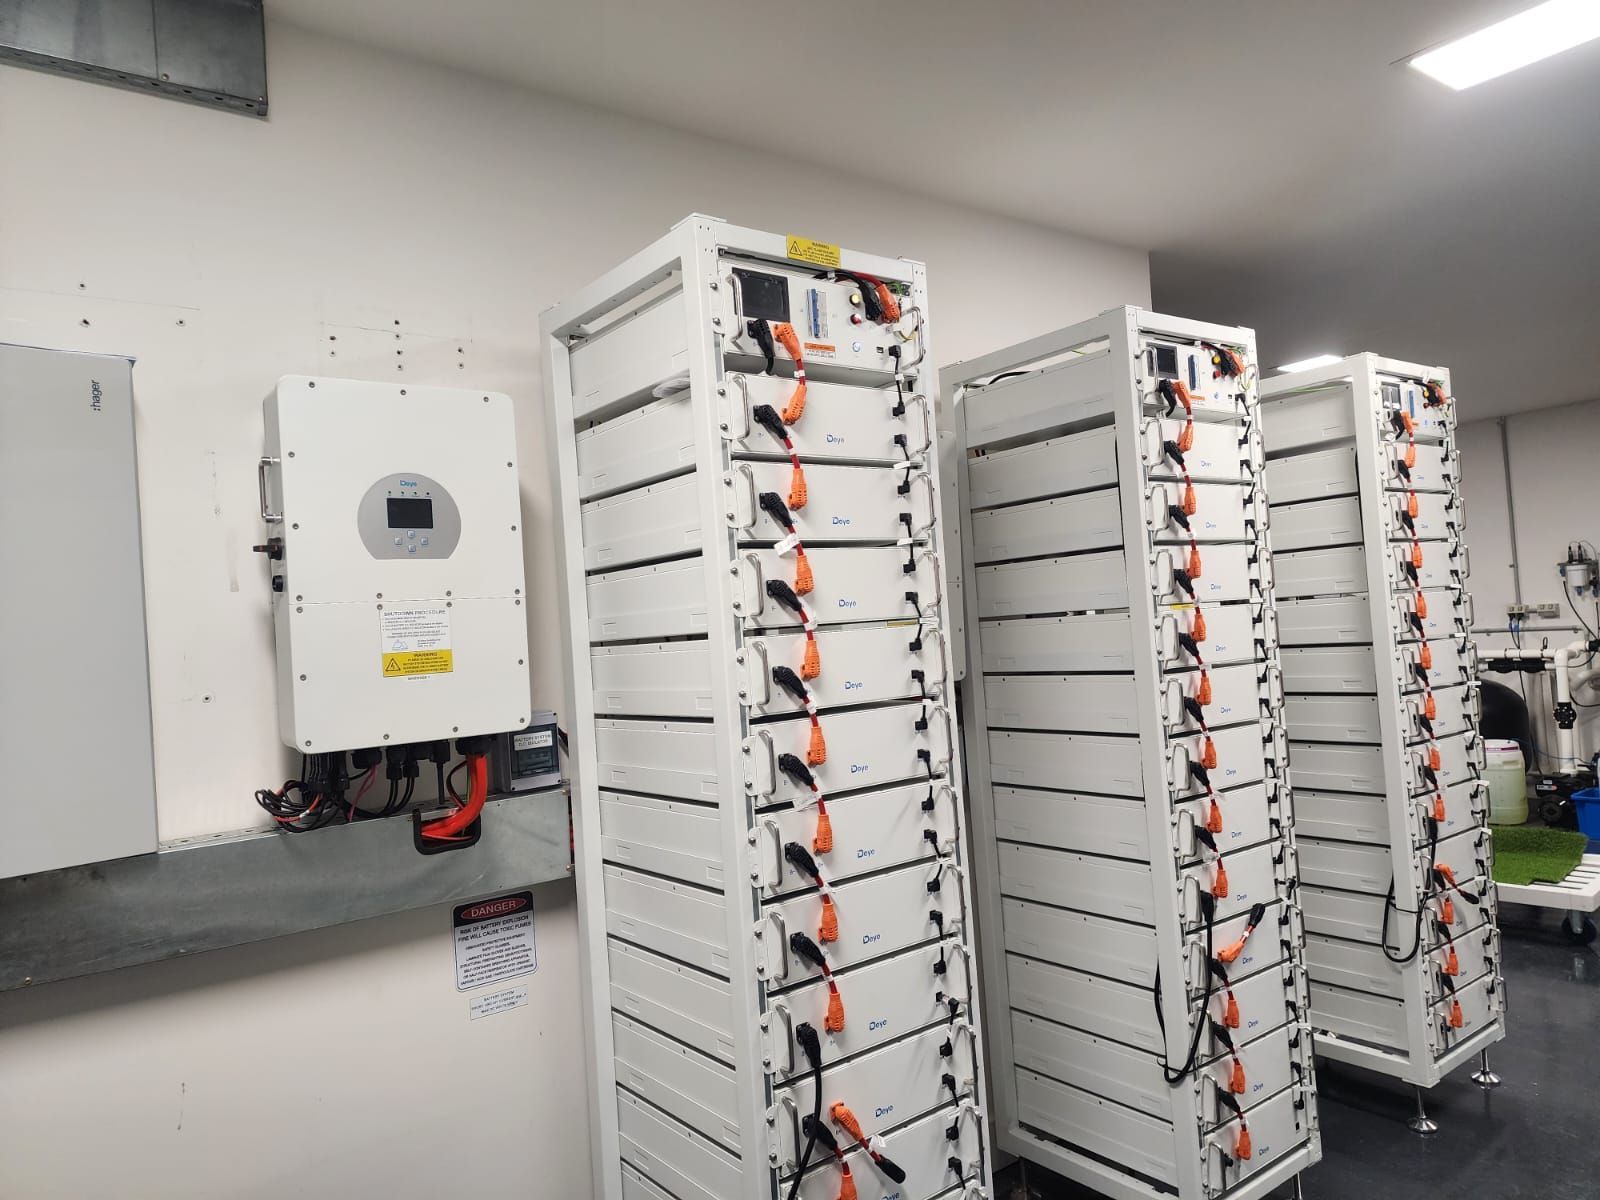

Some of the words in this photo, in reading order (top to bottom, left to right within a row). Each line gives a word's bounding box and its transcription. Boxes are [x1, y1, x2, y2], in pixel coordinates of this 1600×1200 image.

[471, 901, 516, 917] DANGER
[481, 921, 501, 930] BATTERY
[470, 932, 482, 940] WILL
